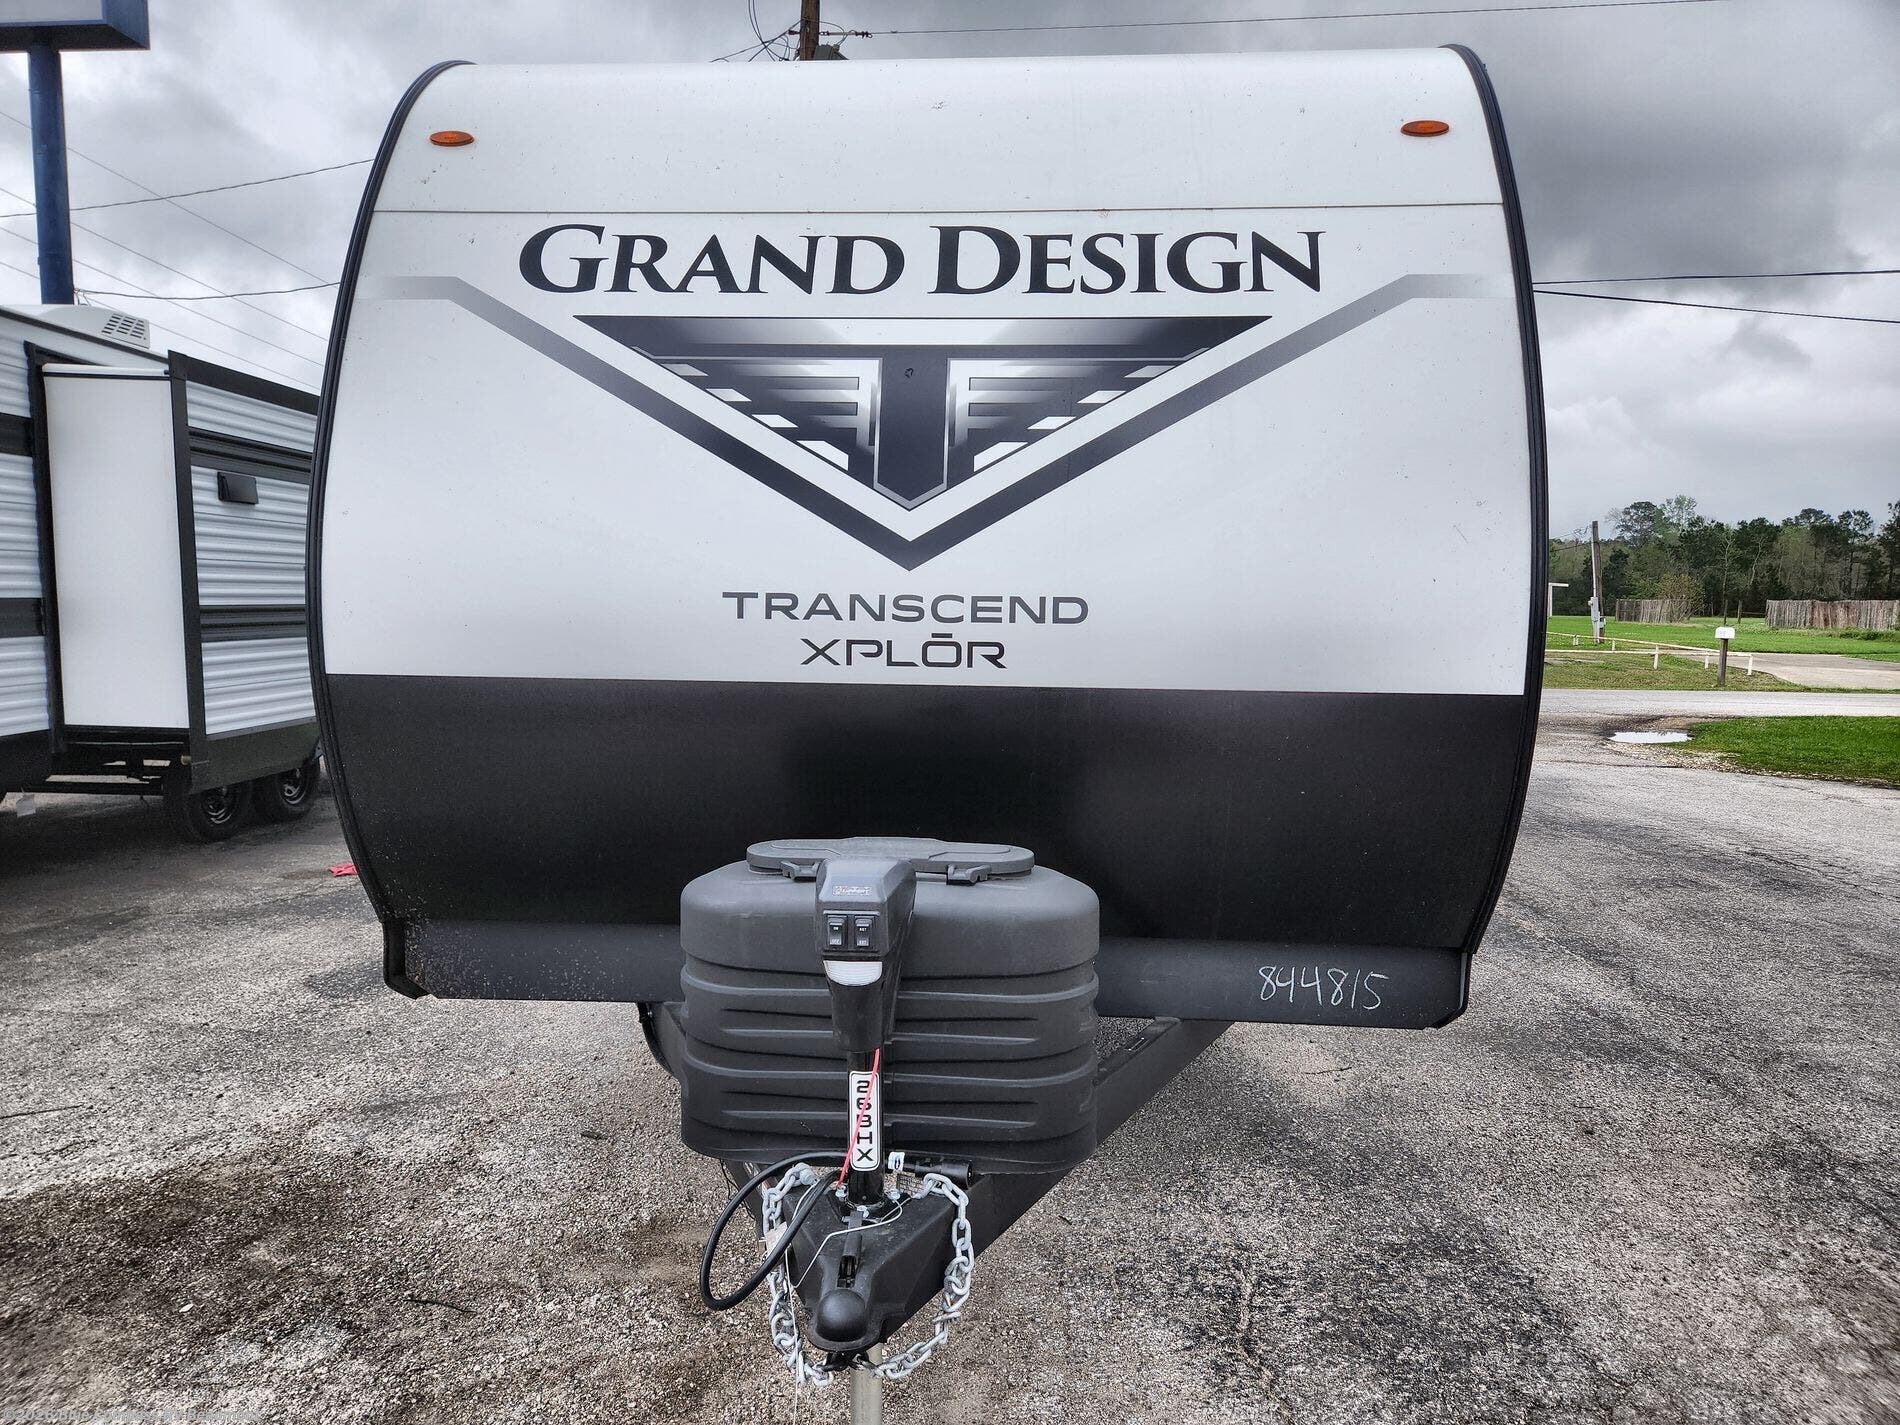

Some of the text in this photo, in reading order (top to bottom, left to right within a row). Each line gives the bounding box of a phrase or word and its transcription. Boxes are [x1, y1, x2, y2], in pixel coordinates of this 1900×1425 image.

[519, 223, 1326, 294] GRAND DESIGN
[721, 591, 1090, 625] TRANSCEND
[1258, 965, 1390, 1010] 844815
